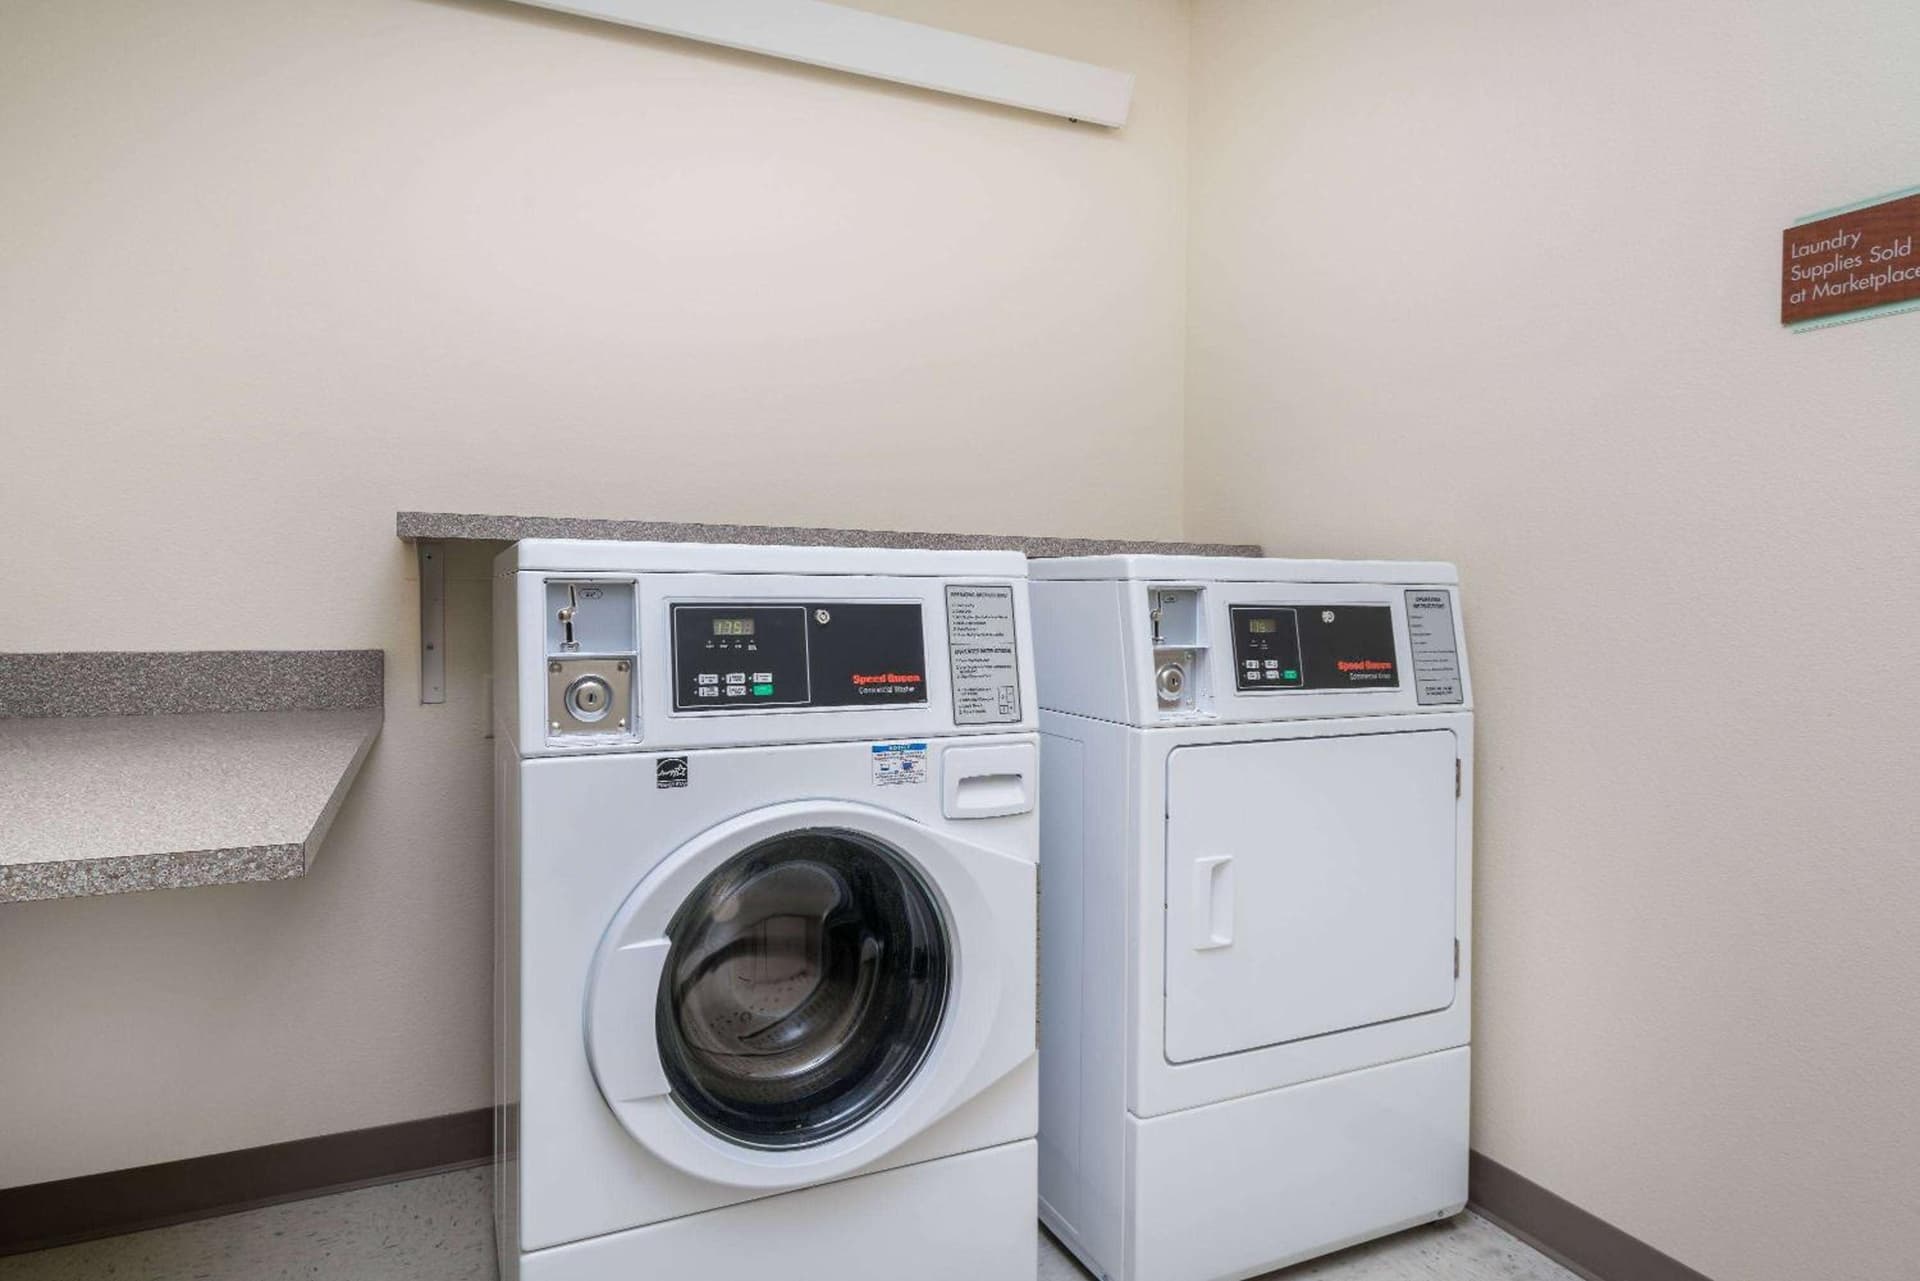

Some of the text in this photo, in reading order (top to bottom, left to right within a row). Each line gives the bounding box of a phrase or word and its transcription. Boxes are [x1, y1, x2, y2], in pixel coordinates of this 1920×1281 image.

[1791, 228, 1861, 259] Laundry
[1791, 235, 1912, 281] Supplies Sold
[1790, 288, 1806, 304] at
[852, 673, 921, 685] Speed Queen
